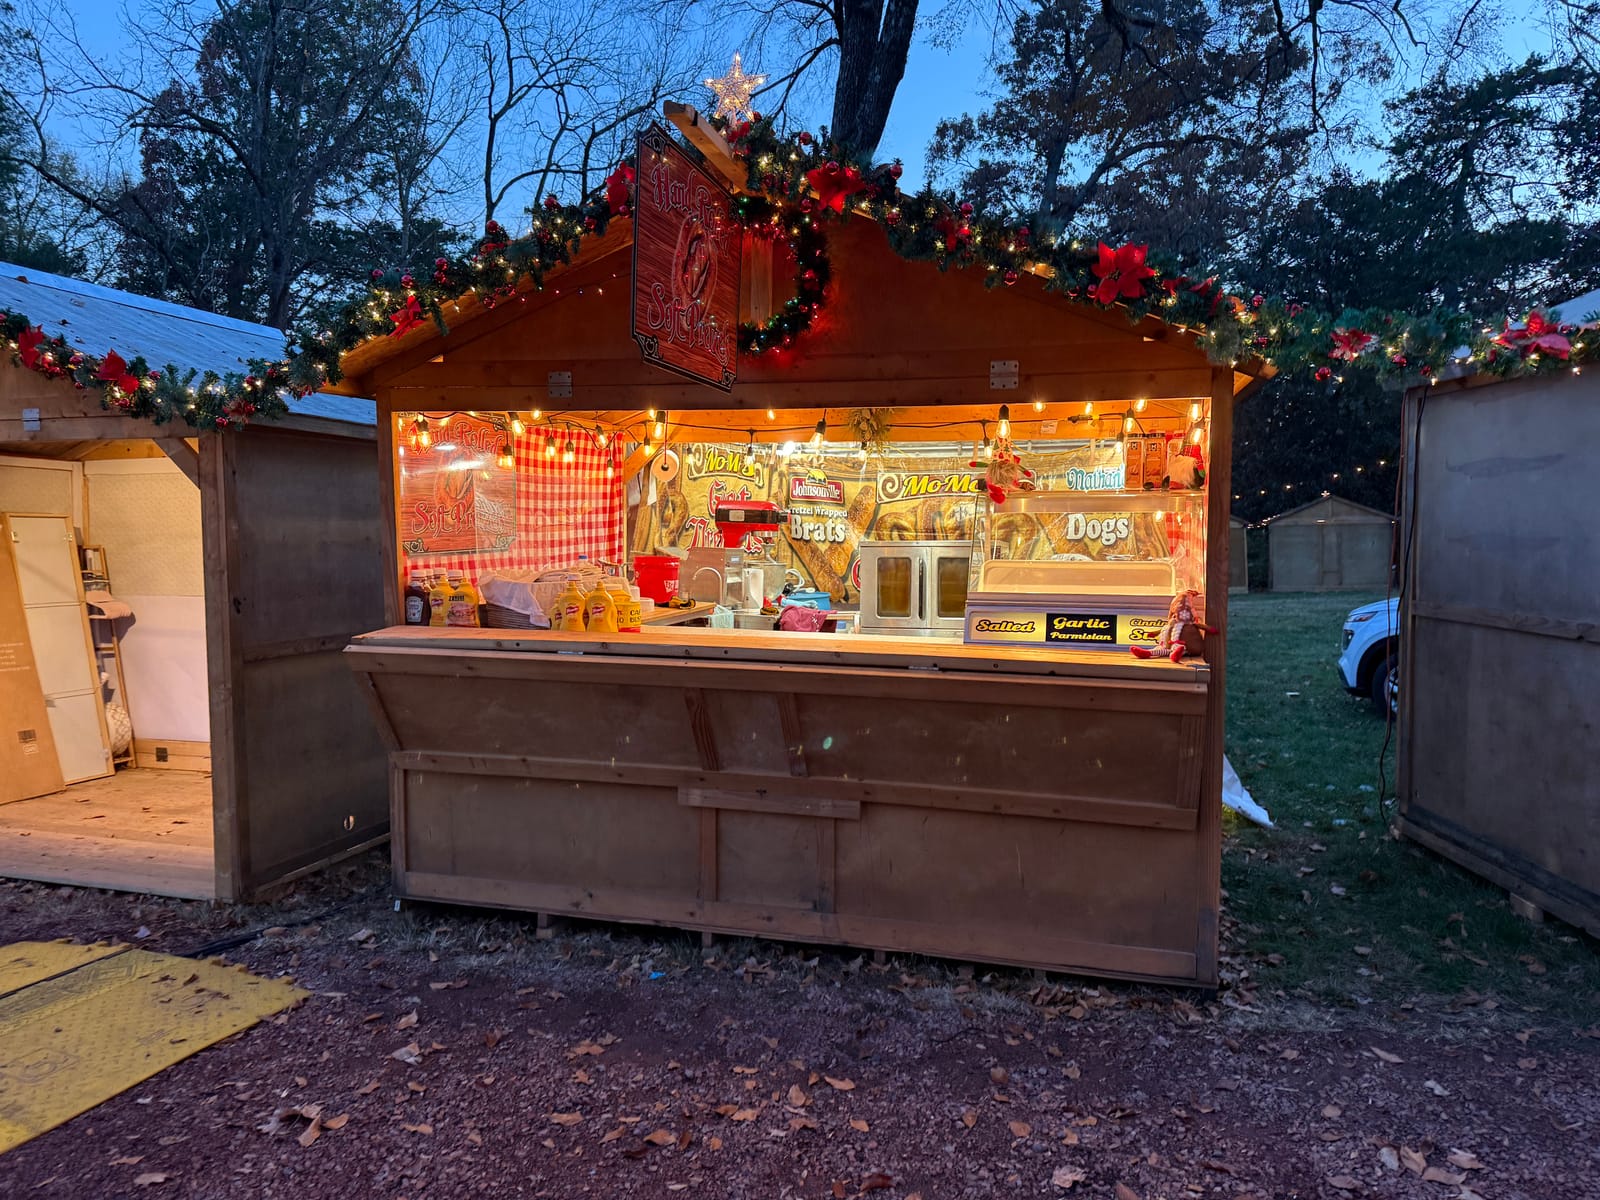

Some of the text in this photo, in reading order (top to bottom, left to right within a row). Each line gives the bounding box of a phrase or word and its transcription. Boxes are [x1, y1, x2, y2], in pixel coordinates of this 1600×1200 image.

[650, 162, 697, 214] Hand
[647, 282, 686, 344] Soft
[793, 480, 840, 499] Johnsonville
[411, 500, 452, 538] Soft
[788, 505, 848, 519] retzel Wrapped
[791, 514, 846, 543] Brats
[1066, 512, 1129, 546] Dogs
[976, 619, 1036, 633] Salted
[1053, 616, 1110, 630] Garlic
